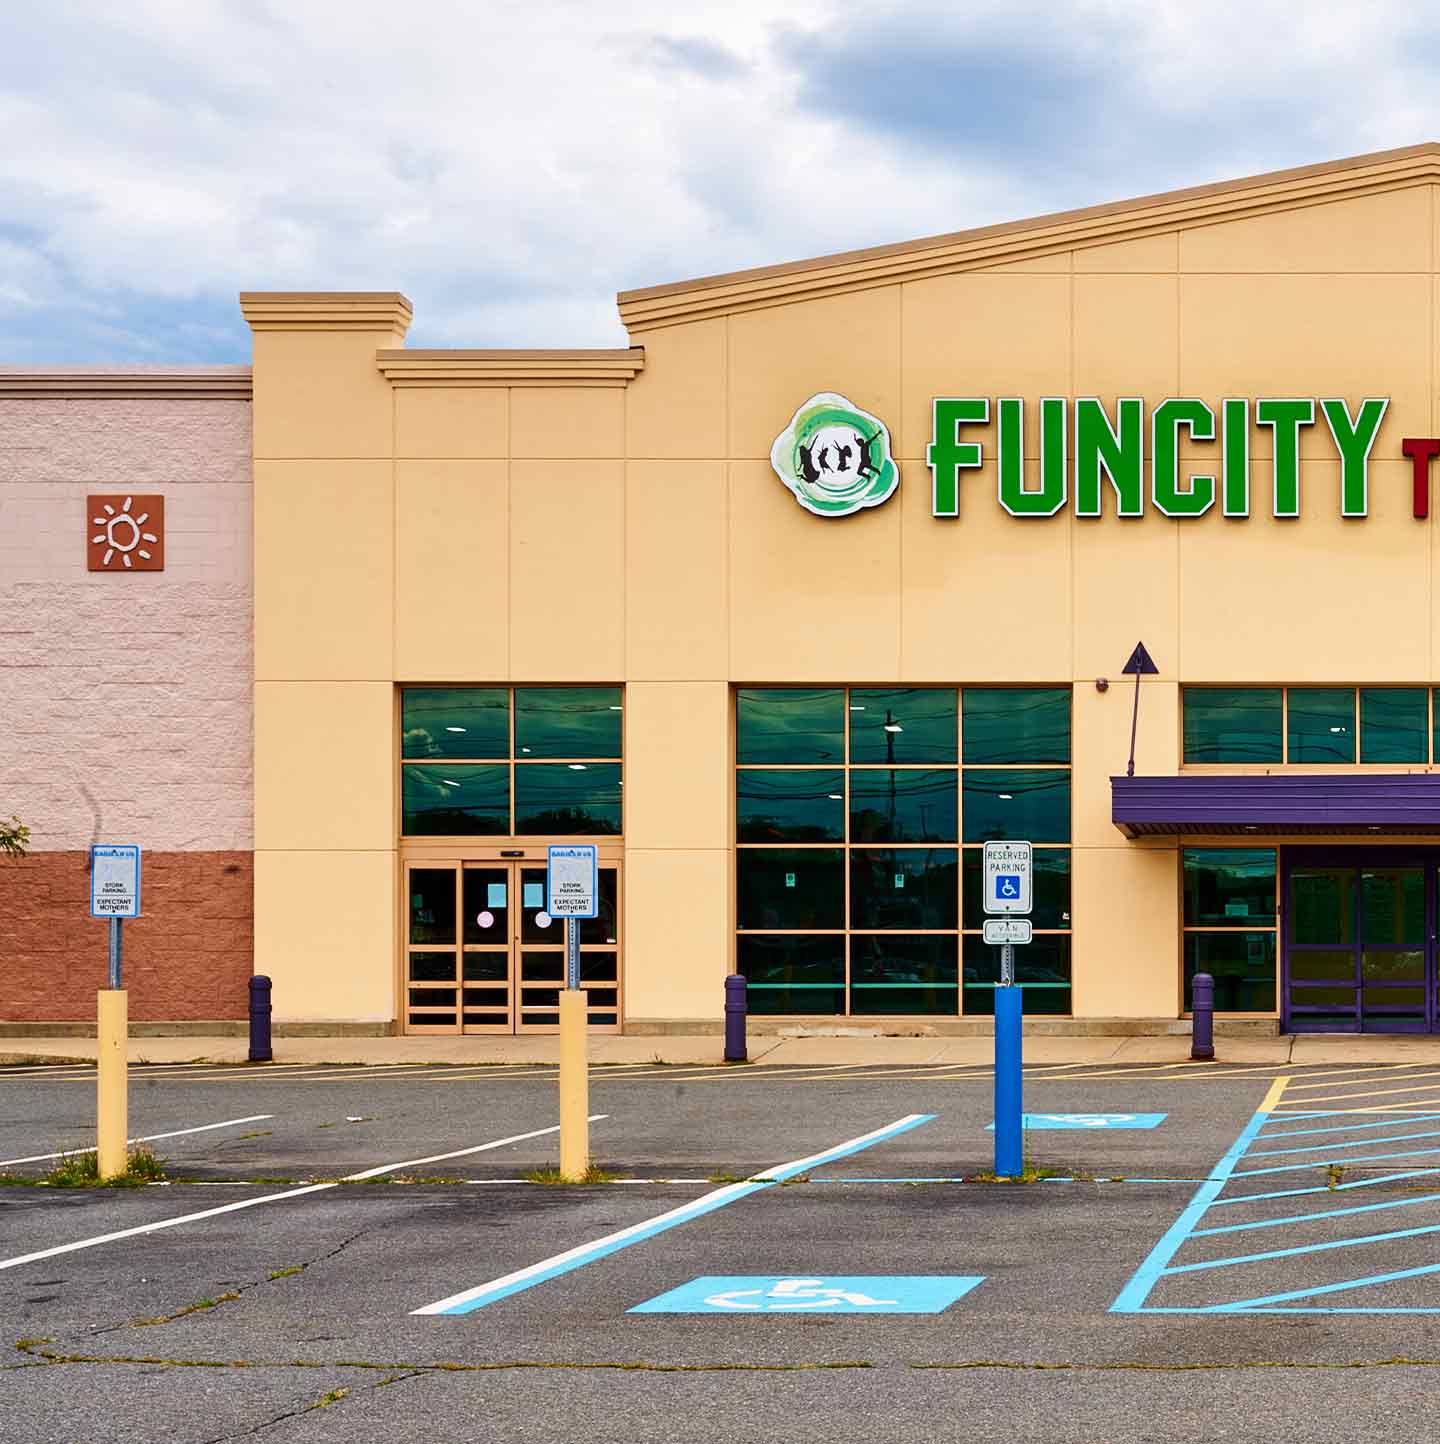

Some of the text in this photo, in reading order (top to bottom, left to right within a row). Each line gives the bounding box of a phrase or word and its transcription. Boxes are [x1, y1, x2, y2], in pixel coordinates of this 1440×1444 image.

[926, 397, 1391, 519] FUNCITY
[988, 851, 1028, 860] RESERVED
[990, 863, 1026, 872] PARKING
